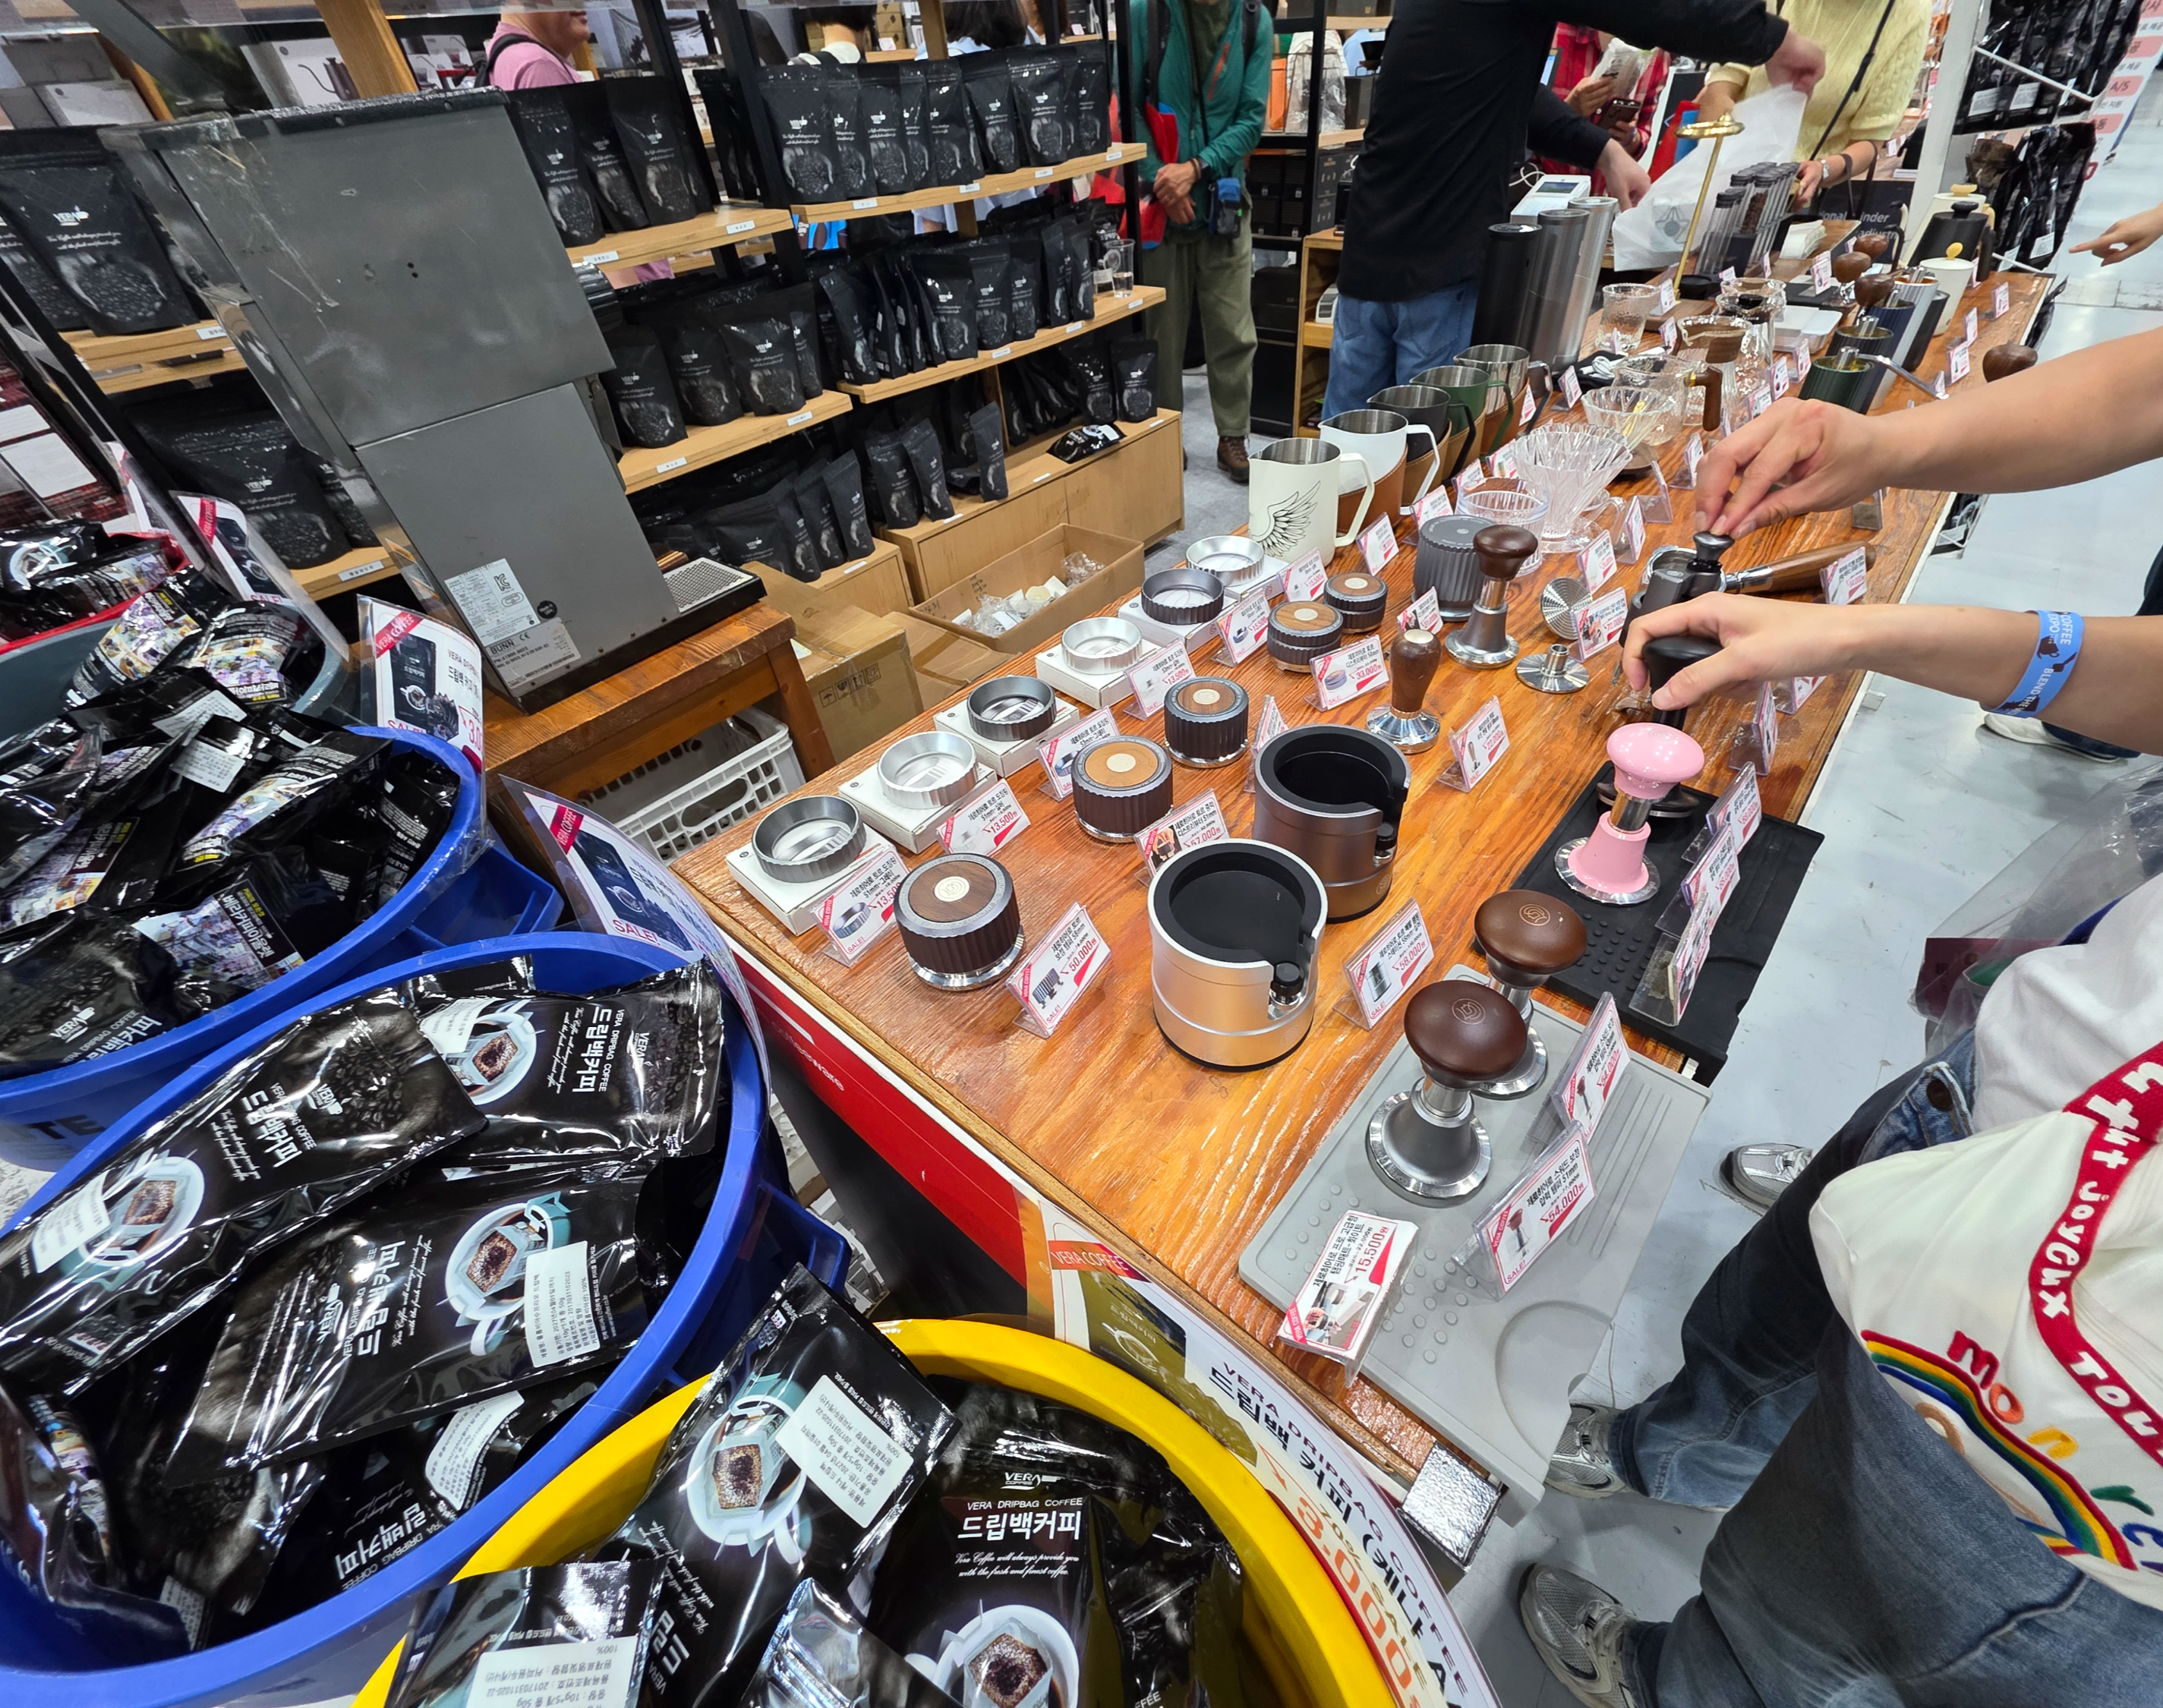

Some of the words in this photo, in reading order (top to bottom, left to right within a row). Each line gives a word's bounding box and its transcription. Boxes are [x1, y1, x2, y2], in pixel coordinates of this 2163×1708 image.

[2048, 613, 2057, 632] EXPO
[2059, 615, 2071, 644] COFFEE
[376, 633, 393, 648] VERA
[490, 639, 514, 654] BUNN
[2030, 666, 2054, 695] BLEND
[2017, 695, 2036, 707] THE
[221, 893, 274, 960] 베라커피아울렛
[609, 918, 662, 945] SALE!
[847, 936, 865, 953] SALE!
[49, 1014, 87, 1038] VERA
[110, 1007, 139, 1031] COFFEE
[613, 1009, 624, 1026] VERA
[572, 1006, 612, 1092] 드립백커피
[605, 1029, 620, 1060] DRIPBAG
[635, 1032, 649, 1059] VERA
[598, 1063, 611, 1092] COFFEE
[315, 1082, 336, 1110] VERA
[294, 1124, 316, 1150] COFFEE
[1050, 1253, 1083, 1264] VERA
[1082, 1253, 1127, 1269] COFFEE
[1354, 1223, 1389, 1275] 15,500원
[1505, 1259, 1528, 1281] SALE!
[348, 1286, 366, 1329] DRIPAG
[342, 1332, 355, 1358] VERA
[884, 1442, 901, 1458] 100%
[1209, 1366, 1290, 1451] 드립백
[1299, 1450, 1352, 1525] 커피
[1004, 1472, 1040, 1486] VERA
[967, 1501, 992, 1510] VERA
[1045, 1497, 1083, 1506] COFFEE
[957, 1511, 1080, 1540] 드립백커피
[1224, 1361, 1279, 1418] VERA
[1287, 1420, 1384, 1543] DRIPBAG
[1390, 1552, 1468, 1698] COFFEE
[334, 1503, 426, 1578] 립백커피
[380, 1532, 423, 1565] DRIPBAG
[1323, 1506, 1362, 1574] 70%
